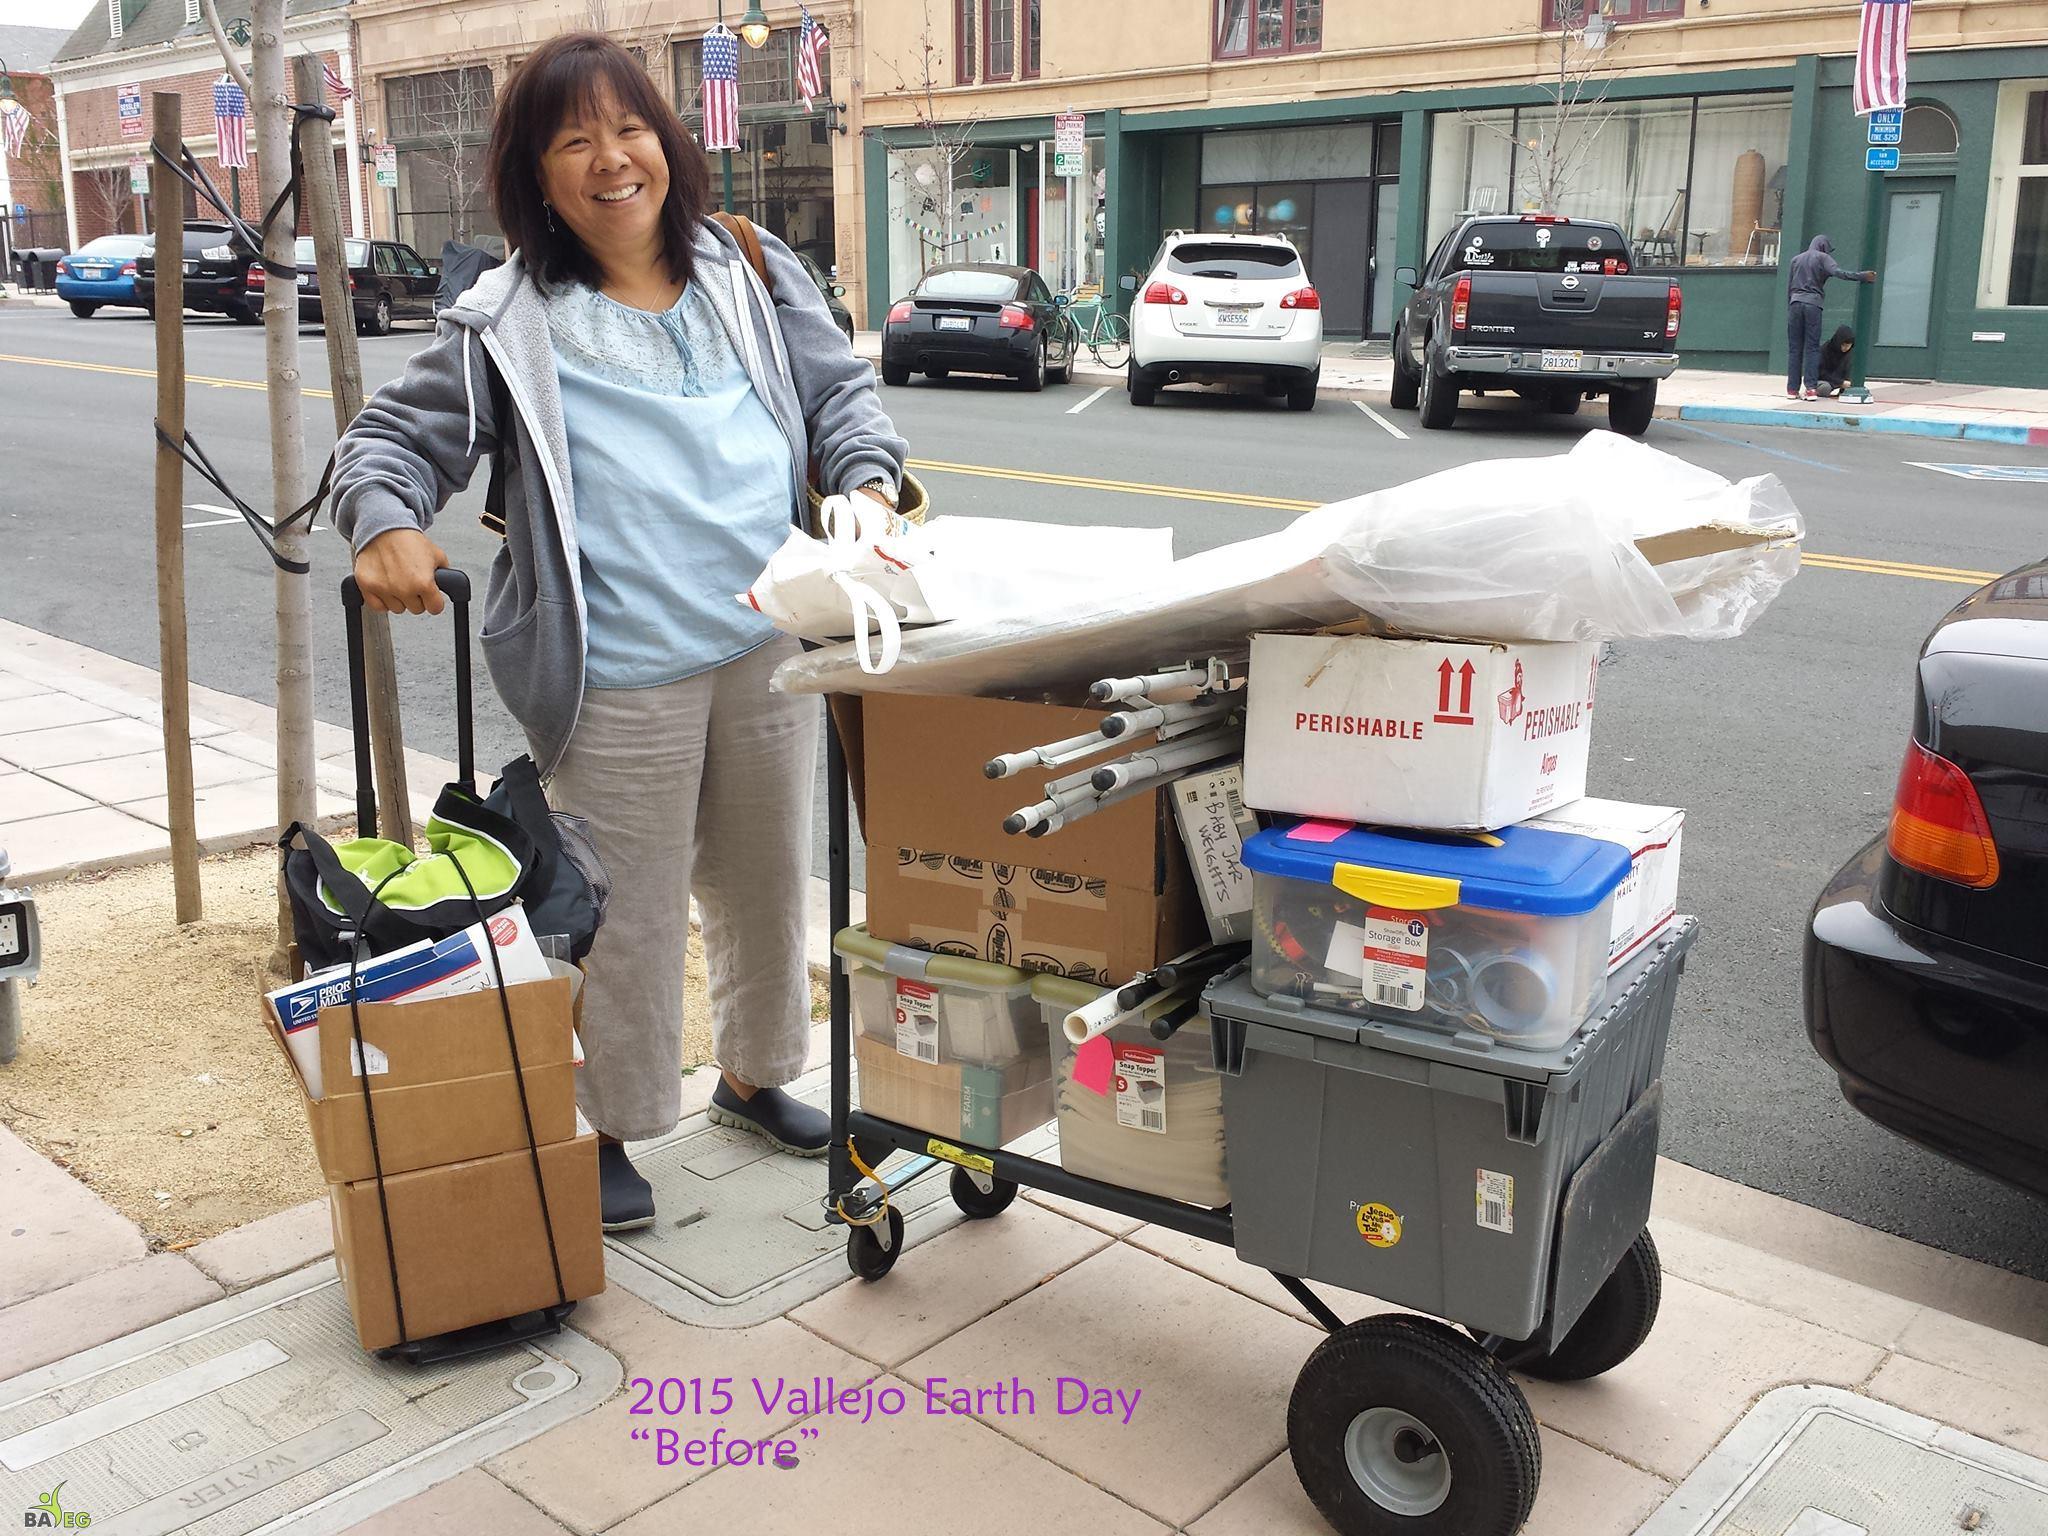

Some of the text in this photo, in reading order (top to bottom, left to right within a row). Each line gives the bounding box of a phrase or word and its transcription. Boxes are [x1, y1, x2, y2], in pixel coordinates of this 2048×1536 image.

[1877, 113, 1896, 124] ONLY
[1874, 126, 1896, 134] MINIMUM
[1870, 133, 1899, 141] FINE $250
[1057, 155, 1064, 165] 2
[1471, 325, 1515, 333] FRONTIER
[1643, 331, 1658, 339] SV
[1543, 357, 1578, 368] 28132C1
[1296, 712, 1423, 740] PERISHABLE
[1523, 701, 1582, 741] PERISHABLE
[1205, 802, 1227, 841] BABY
[1036, 868, 1076, 889] Digi-Key
[1368, 930, 1422, 948] Storage Box
[320, 975, 366, 998] PRIORTY
[320, 993, 347, 1008] MAIL
[900, 995, 932, 1009] Snap Topper
[1119, 1061, 1157, 1074] Snap Topper
[1118, 1080, 1125, 1090] S
[963, 1086, 972, 1112] FARM
[1361, 1212, 1384, 1224] Loves
[1367, 1206, 1395, 1221] Jesus
[1363, 1223, 1379, 1233] Too
[179, 1454, 297, 1509] WATER
